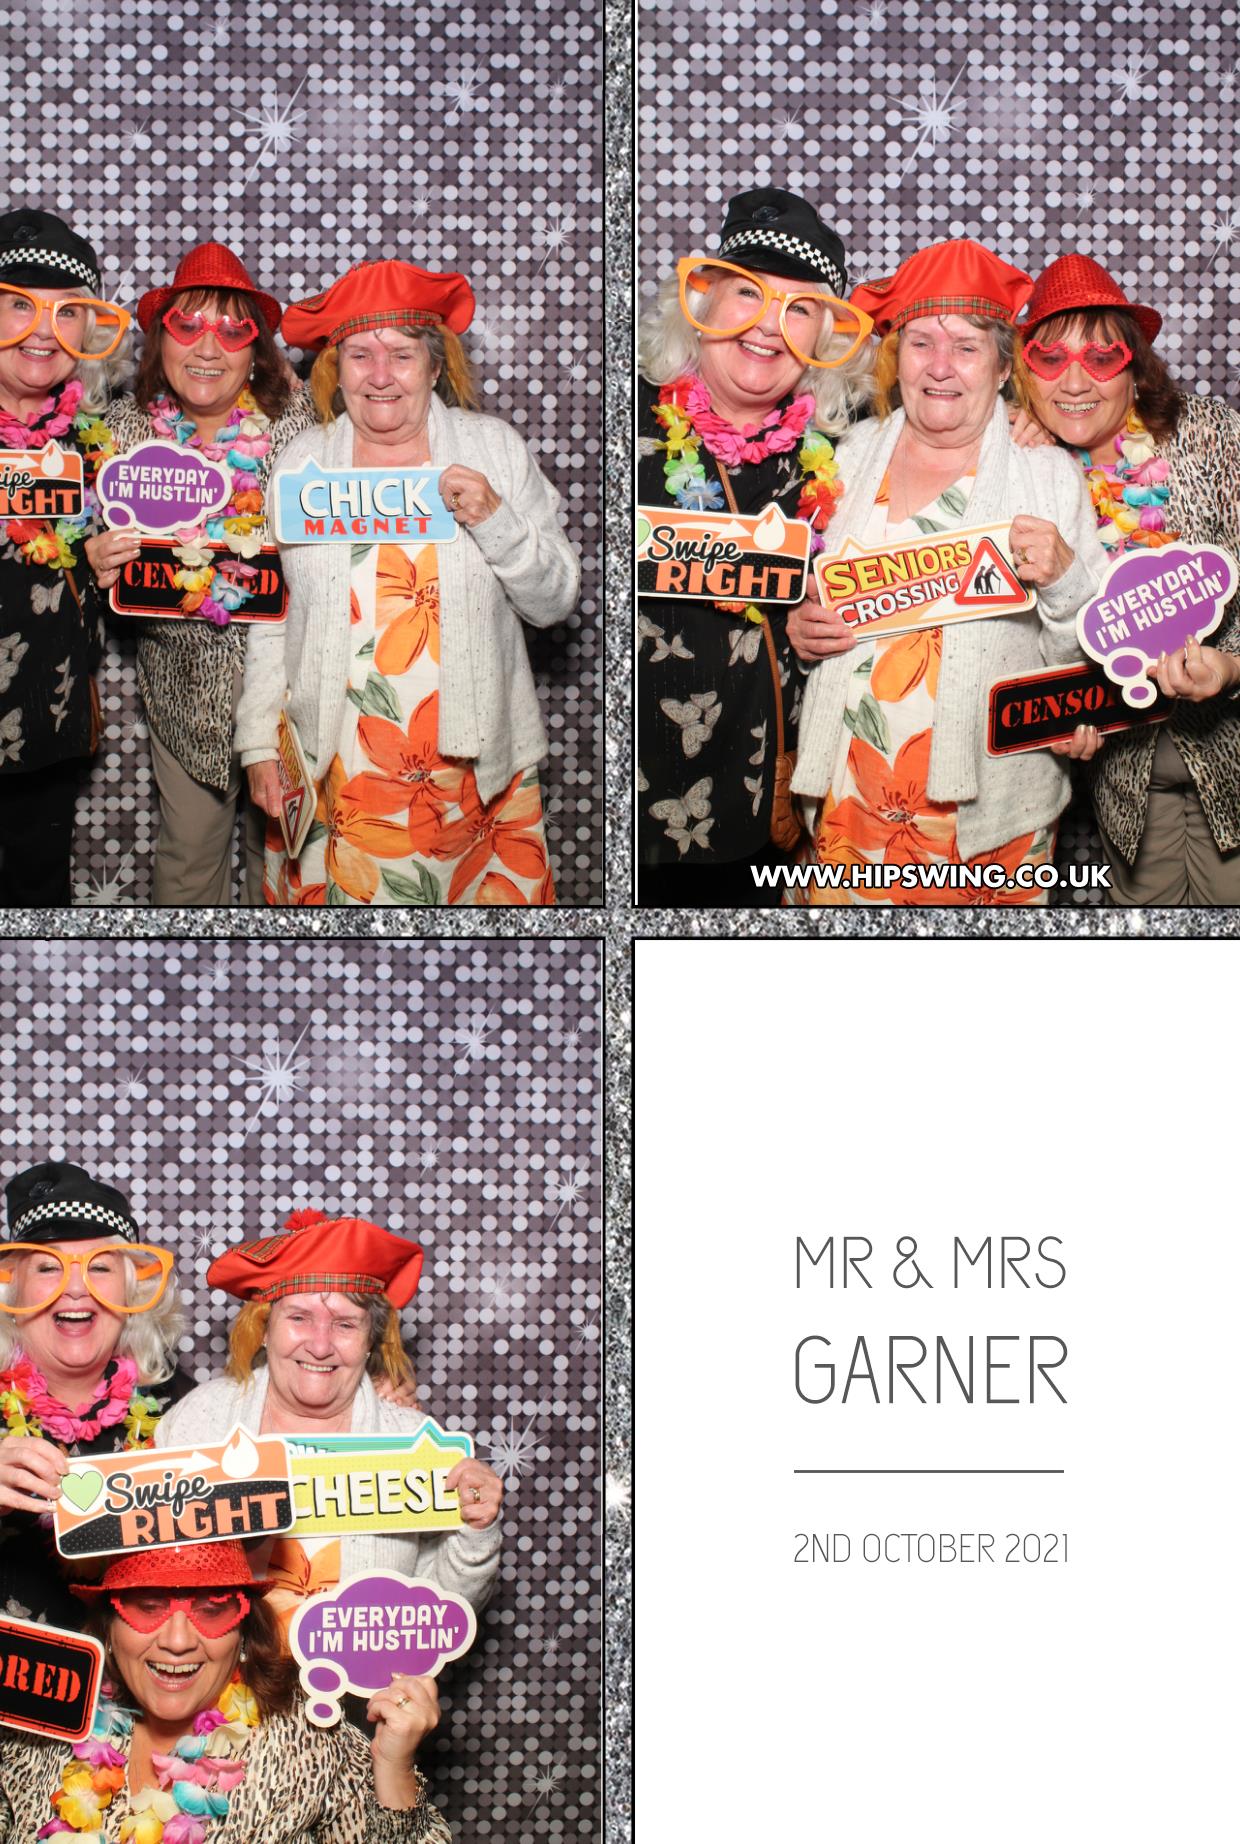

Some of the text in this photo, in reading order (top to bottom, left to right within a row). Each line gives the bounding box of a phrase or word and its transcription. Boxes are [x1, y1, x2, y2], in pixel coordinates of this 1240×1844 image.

[0, 466, 35, 498] ipe
[109, 482, 219, 505] I'M HUSTLIN'
[118, 464, 210, 486] EVERYDAY
[300, 477, 433, 519] CHICK
[0, 488, 80, 515] IGHT
[304, 517, 433, 536] MAGNET
[647, 525, 742, 574] Swipe
[655, 560, 802, 599] RIGHT
[823, 541, 972, 600] SENIORS
[1096, 556, 1205, 624] EVERYDAY
[836, 573, 960, 628] CROSSING
[1095, 570, 1223, 650] I'M HUSTLIN'
[1001, 683, 1115, 729] CENSO
[104, 1471, 213, 1518] Swipe
[292, 1467, 458, 1520] CHEESE
[120, 1491, 287, 1546] RIGHT
[309, 1625, 460, 1653] I'M HUSTLIN'
[322, 1604, 449, 1629] EVERYDAY
[0, 1653, 81, 1703] RED
